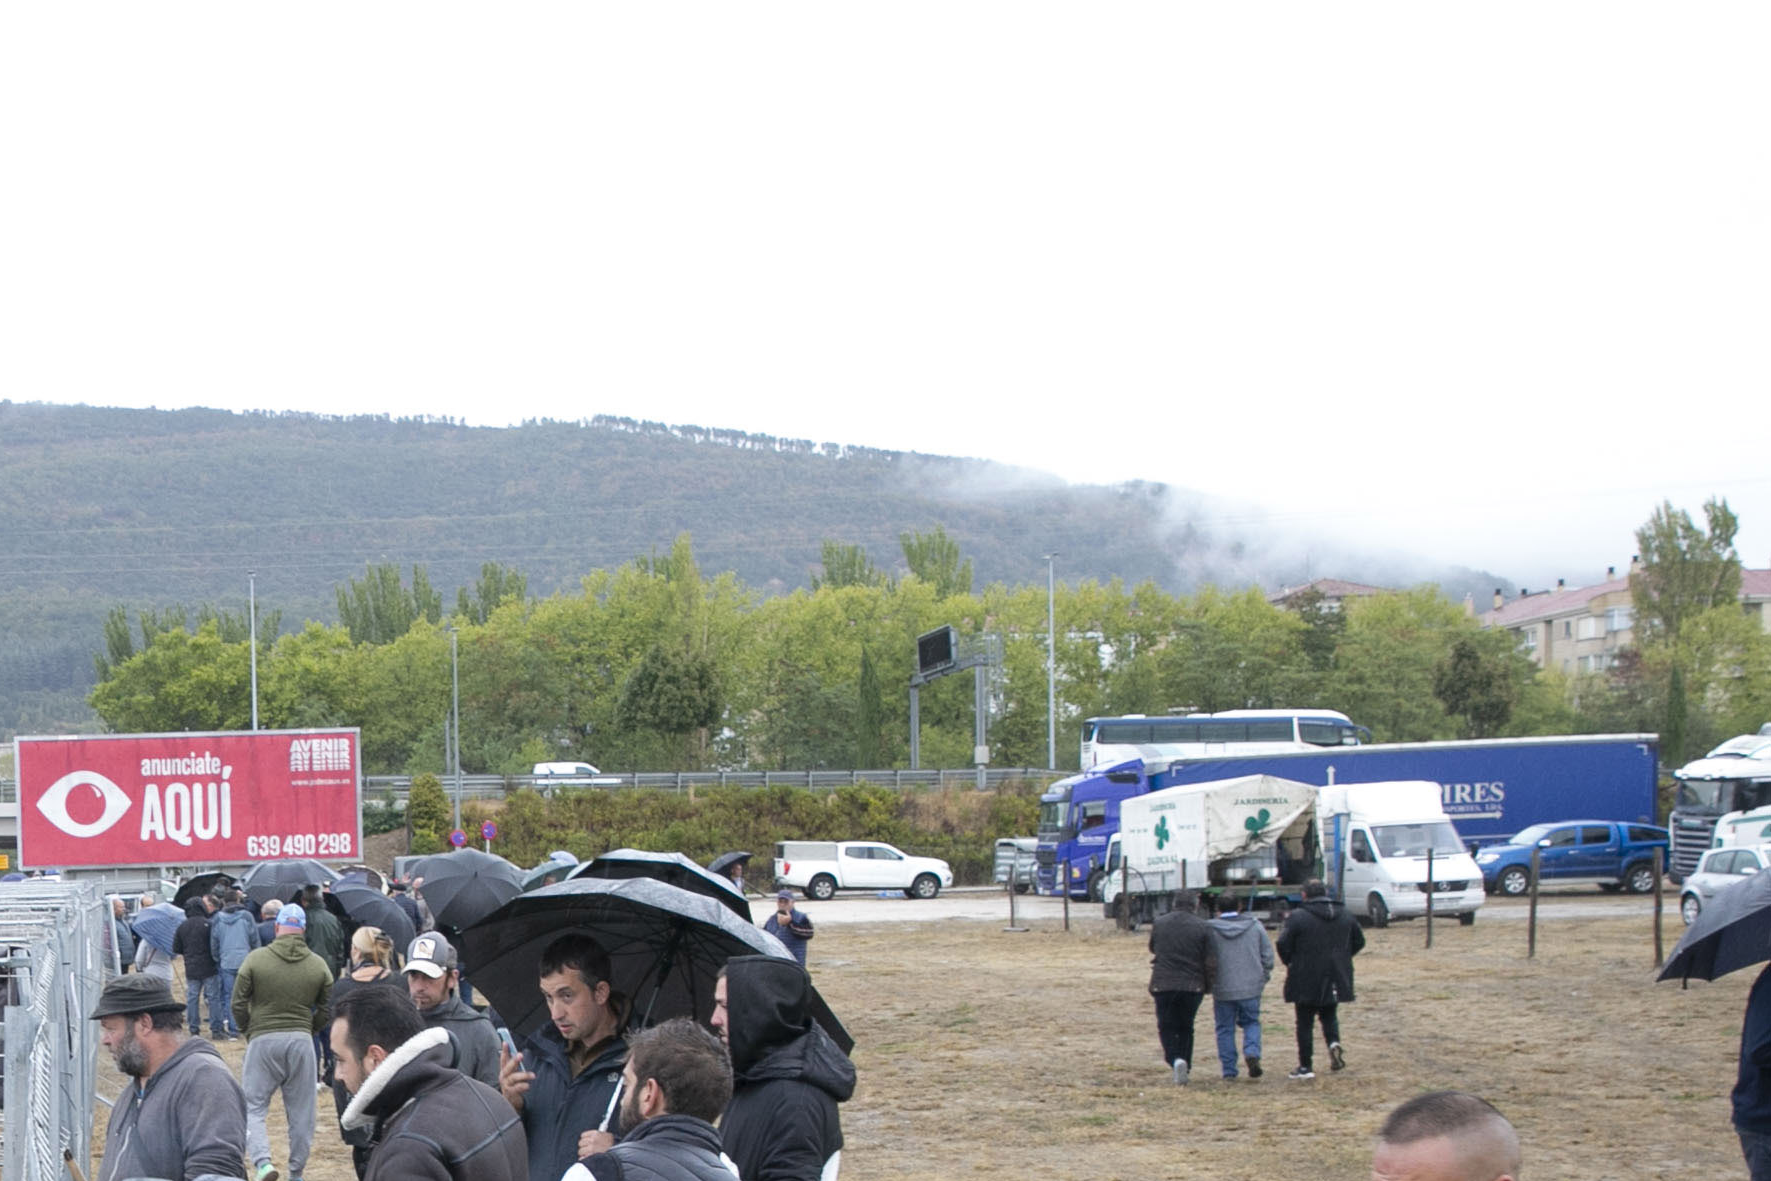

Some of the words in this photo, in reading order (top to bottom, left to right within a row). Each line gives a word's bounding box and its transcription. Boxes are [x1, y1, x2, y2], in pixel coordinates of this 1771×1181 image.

[140, 751, 222, 777] anunciate
[140, 765, 233, 846] AQUÍ
[1440, 782, 1505, 804] IRES
[247, 835, 281, 857] 639
[283, 833, 316, 856] 490
[318, 832, 352, 855] 298
